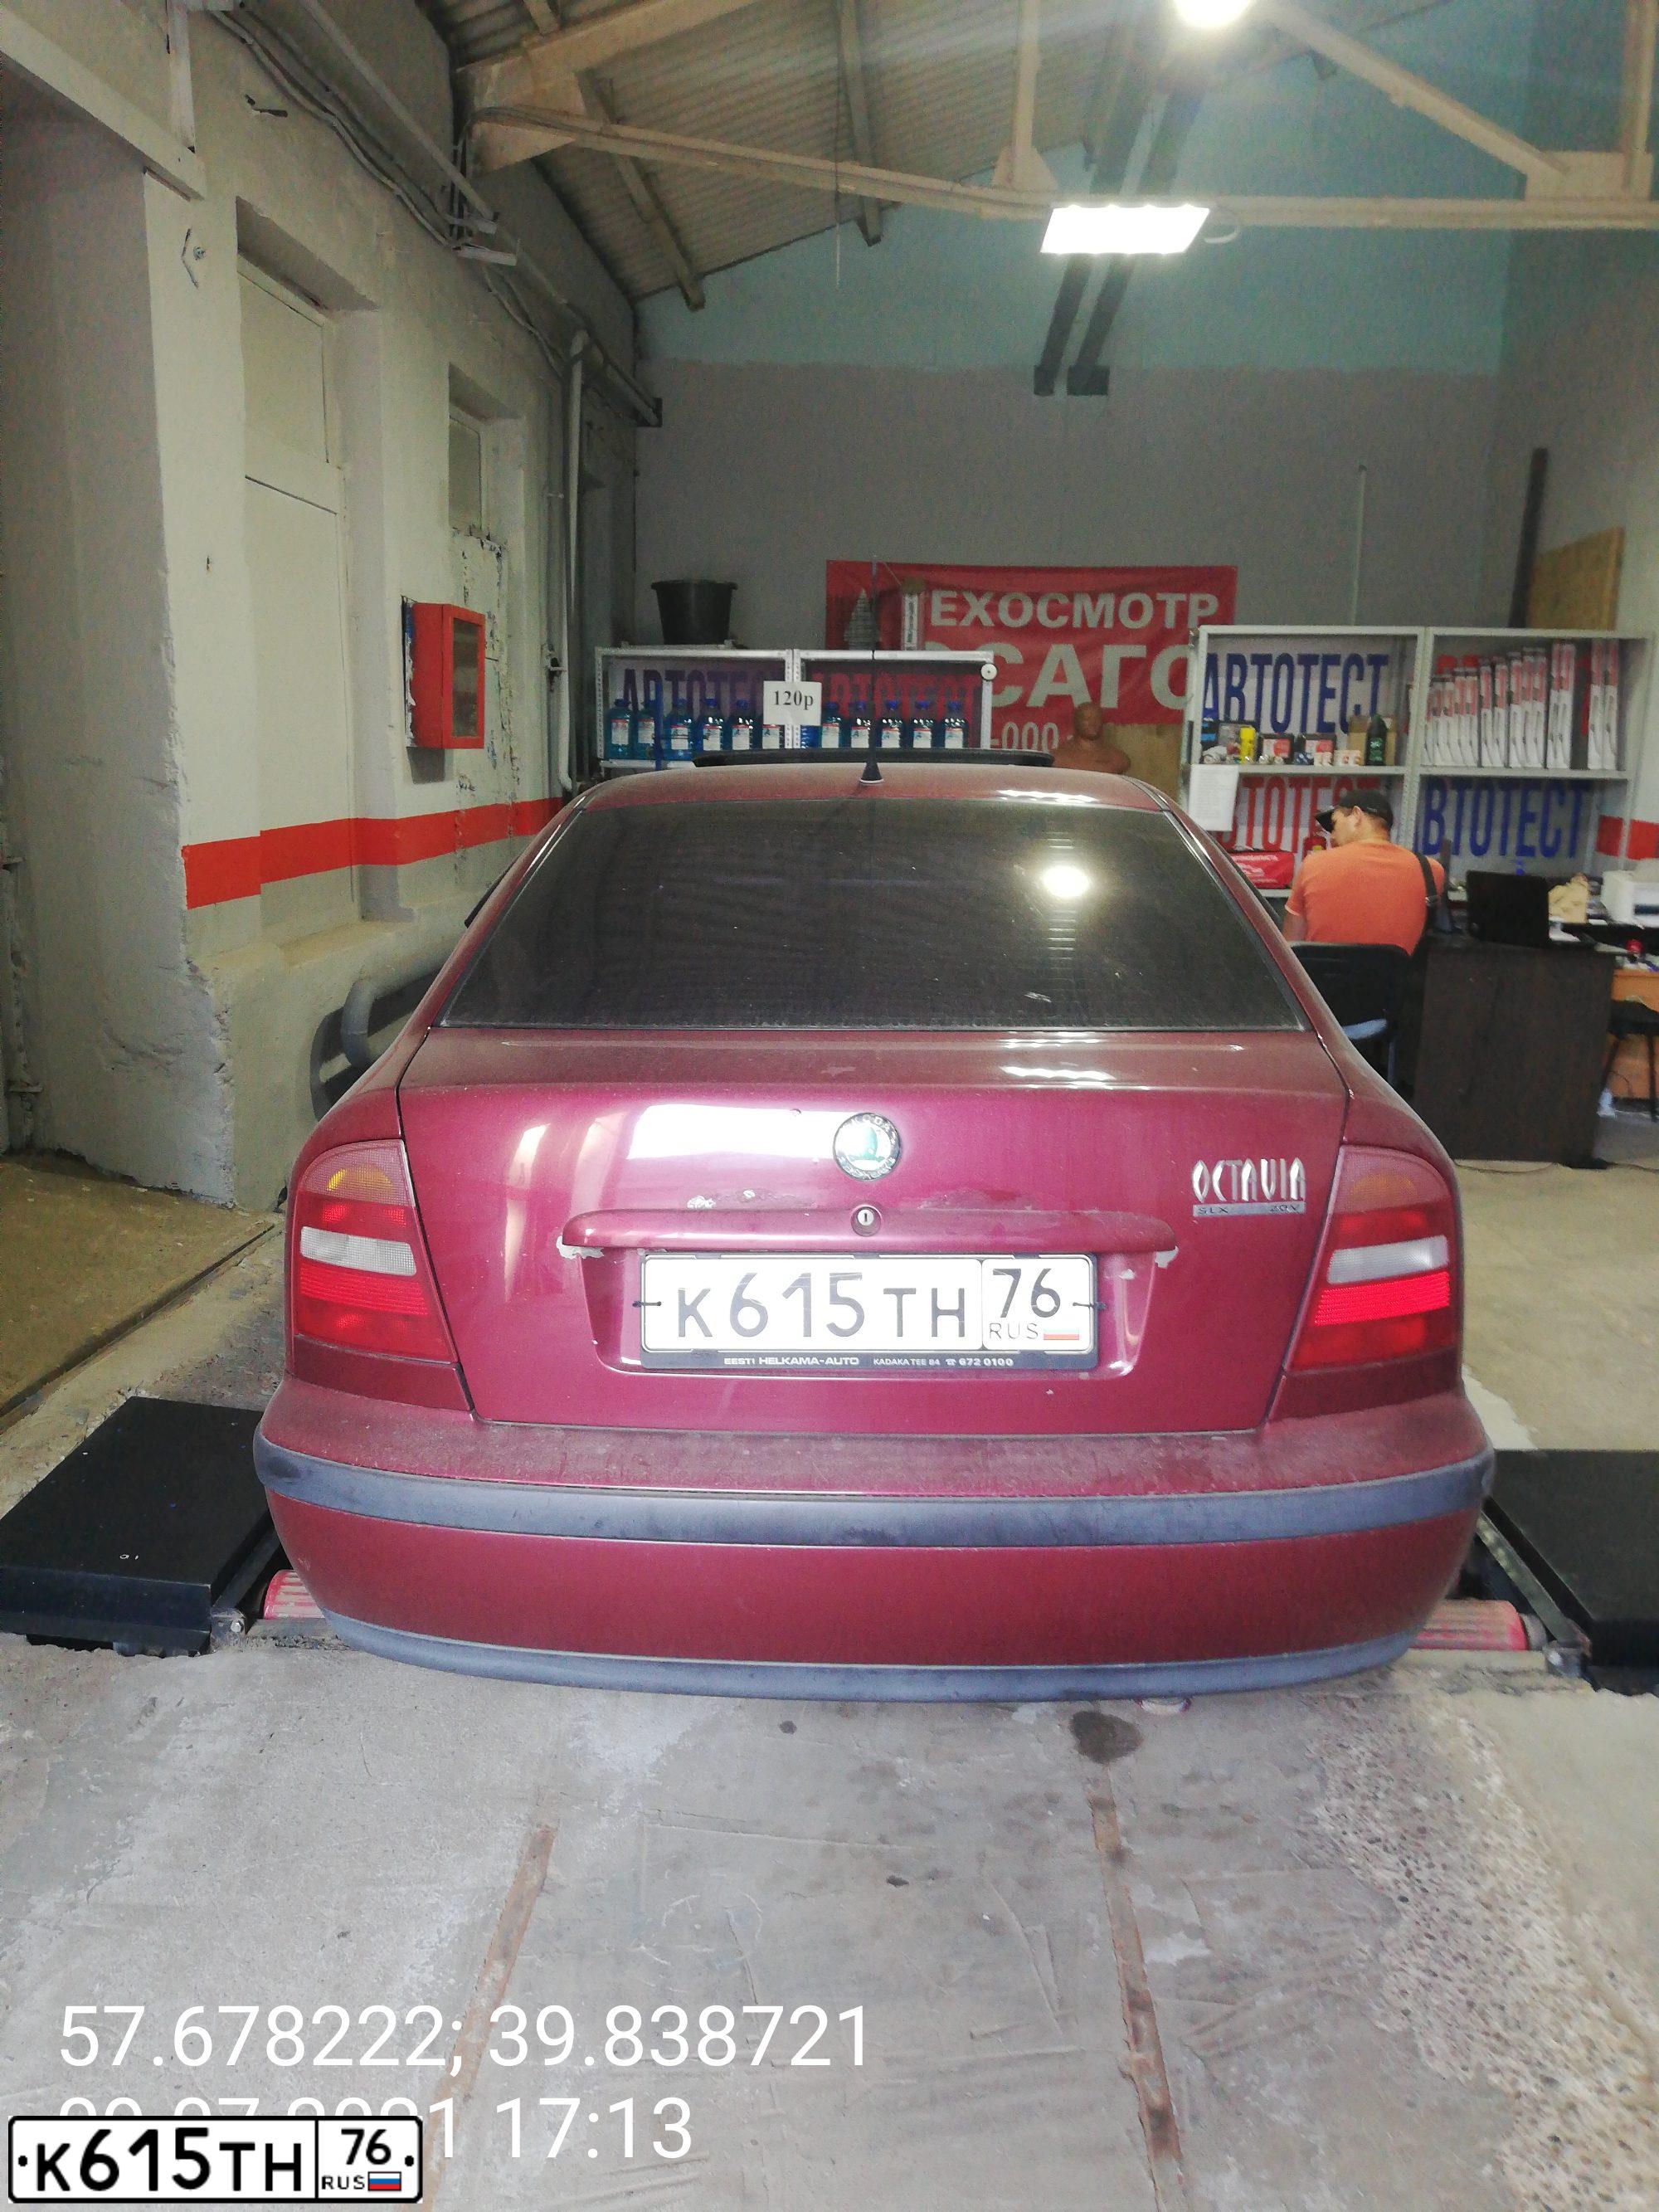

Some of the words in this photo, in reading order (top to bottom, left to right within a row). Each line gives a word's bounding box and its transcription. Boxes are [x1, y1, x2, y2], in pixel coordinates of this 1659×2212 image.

[930, 589, 1219, 630] ЕХОСМОТР
[925, 641, 1192, 711] САГО
[1413, 777, 1593, 858] ВТОТЕСТ
[1192, 1157, 1306, 1203] OCTAVIA
[993, 1268, 1061, 1318] 76
[989, 1323, 1039, 1339] RUS
[759, 1357, 859, 1366] HELKAMA-AUTO
